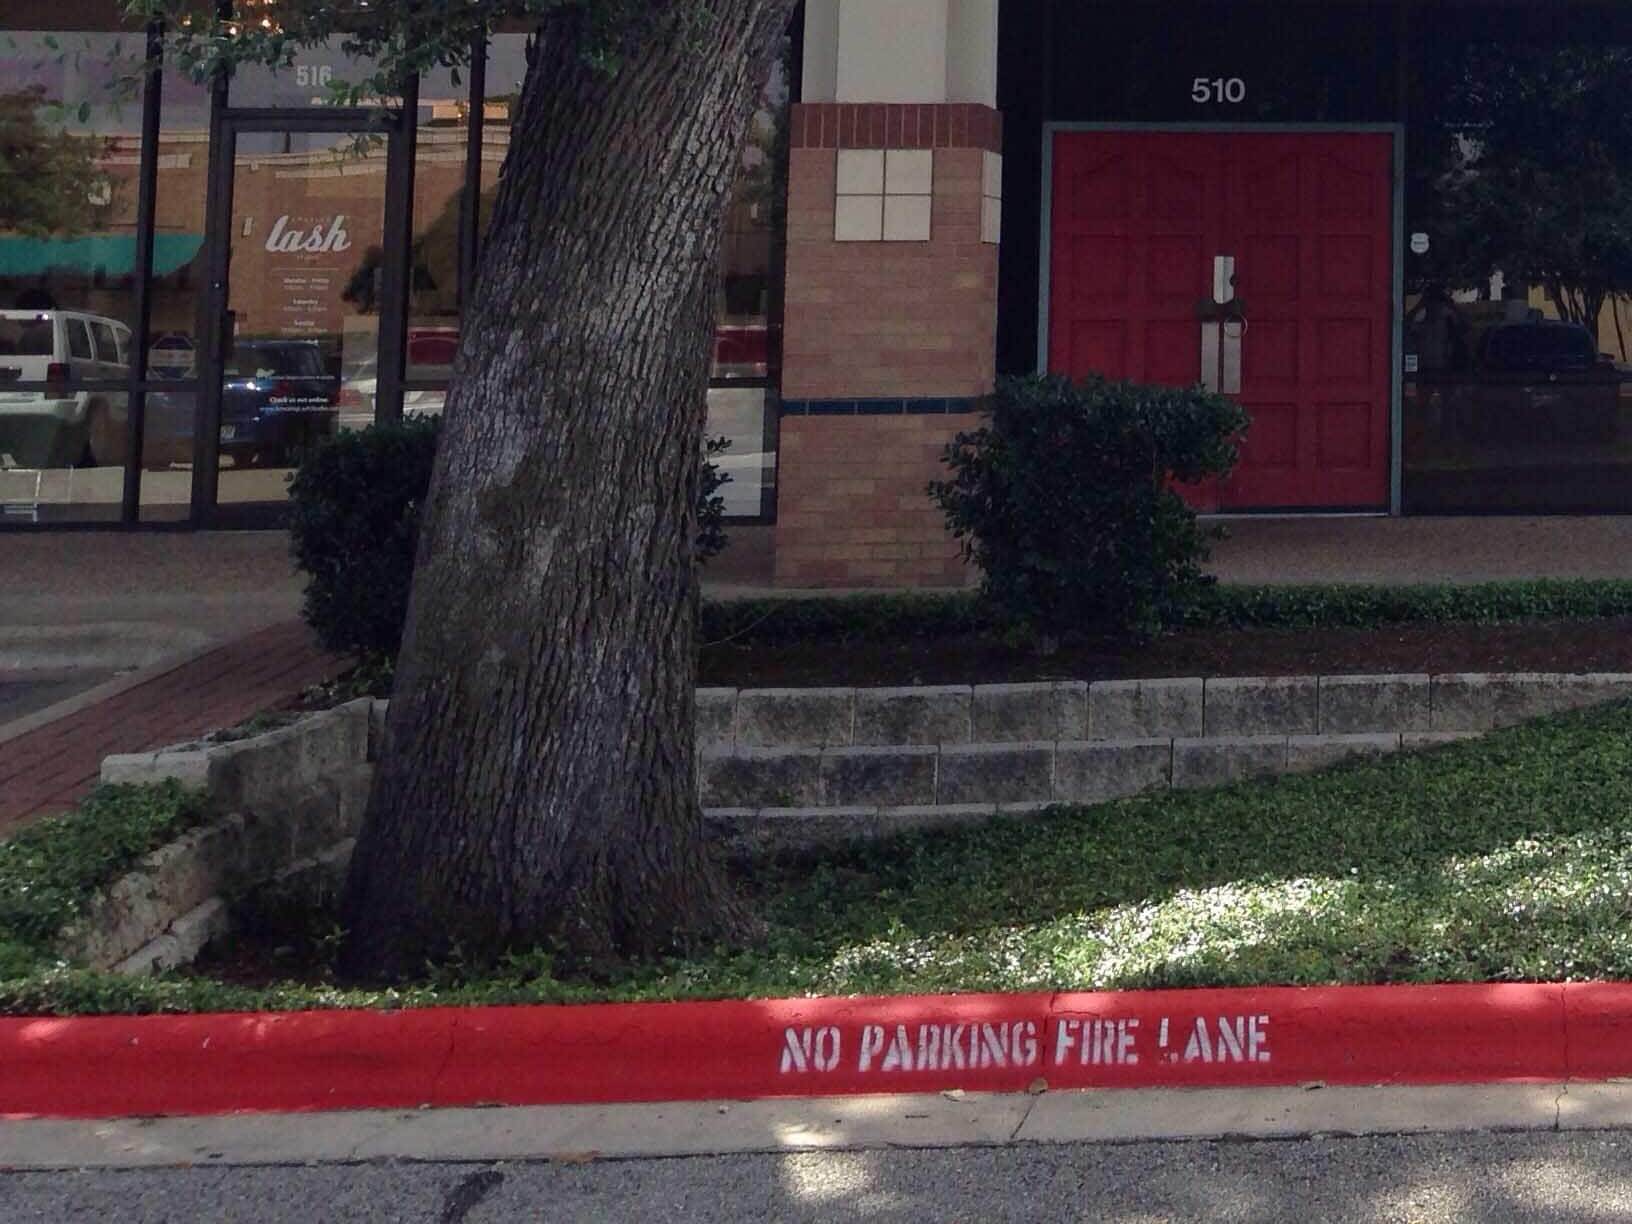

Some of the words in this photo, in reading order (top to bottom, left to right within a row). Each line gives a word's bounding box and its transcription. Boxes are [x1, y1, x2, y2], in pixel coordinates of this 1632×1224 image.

[296, 64, 332, 87] 516
[1192, 78, 1246, 103] 510
[265, 215, 352, 252] lash
[780, 1025, 840, 1074] NO
[858, 1021, 1038, 1074] PARKING
[1055, 1018, 1140, 1065] FIRE
[1159, 1015, 1272, 1064] LANE
